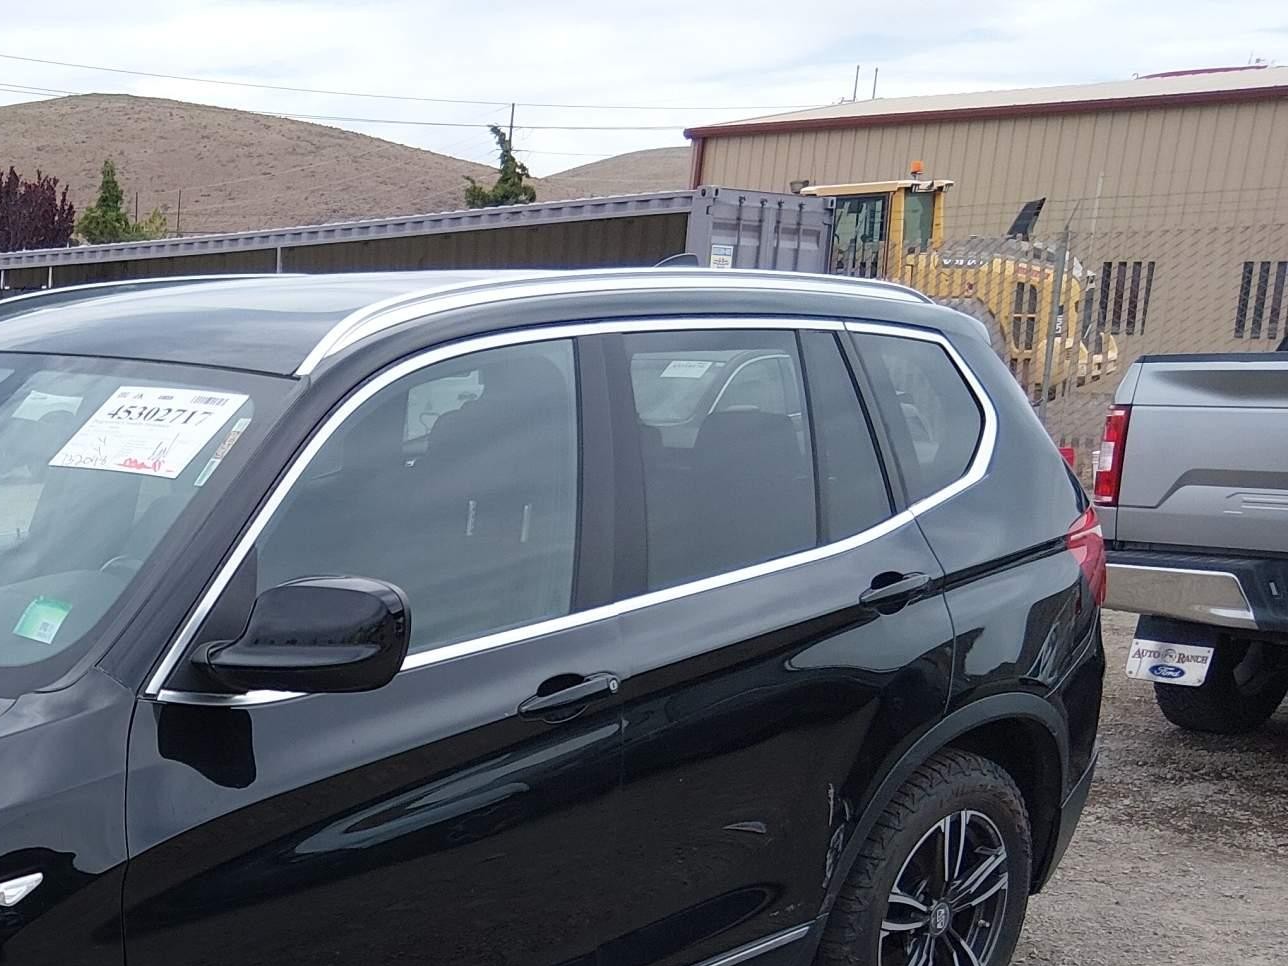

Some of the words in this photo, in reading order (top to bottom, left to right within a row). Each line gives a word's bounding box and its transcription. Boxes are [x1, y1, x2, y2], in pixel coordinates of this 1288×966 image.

[107, 404, 214, 427] 45302717
[1132, 648, 1161, 659] AUTO
[1176, 652, 1209, 664] RANCH
[1152, 666, 1182, 677] Ford
